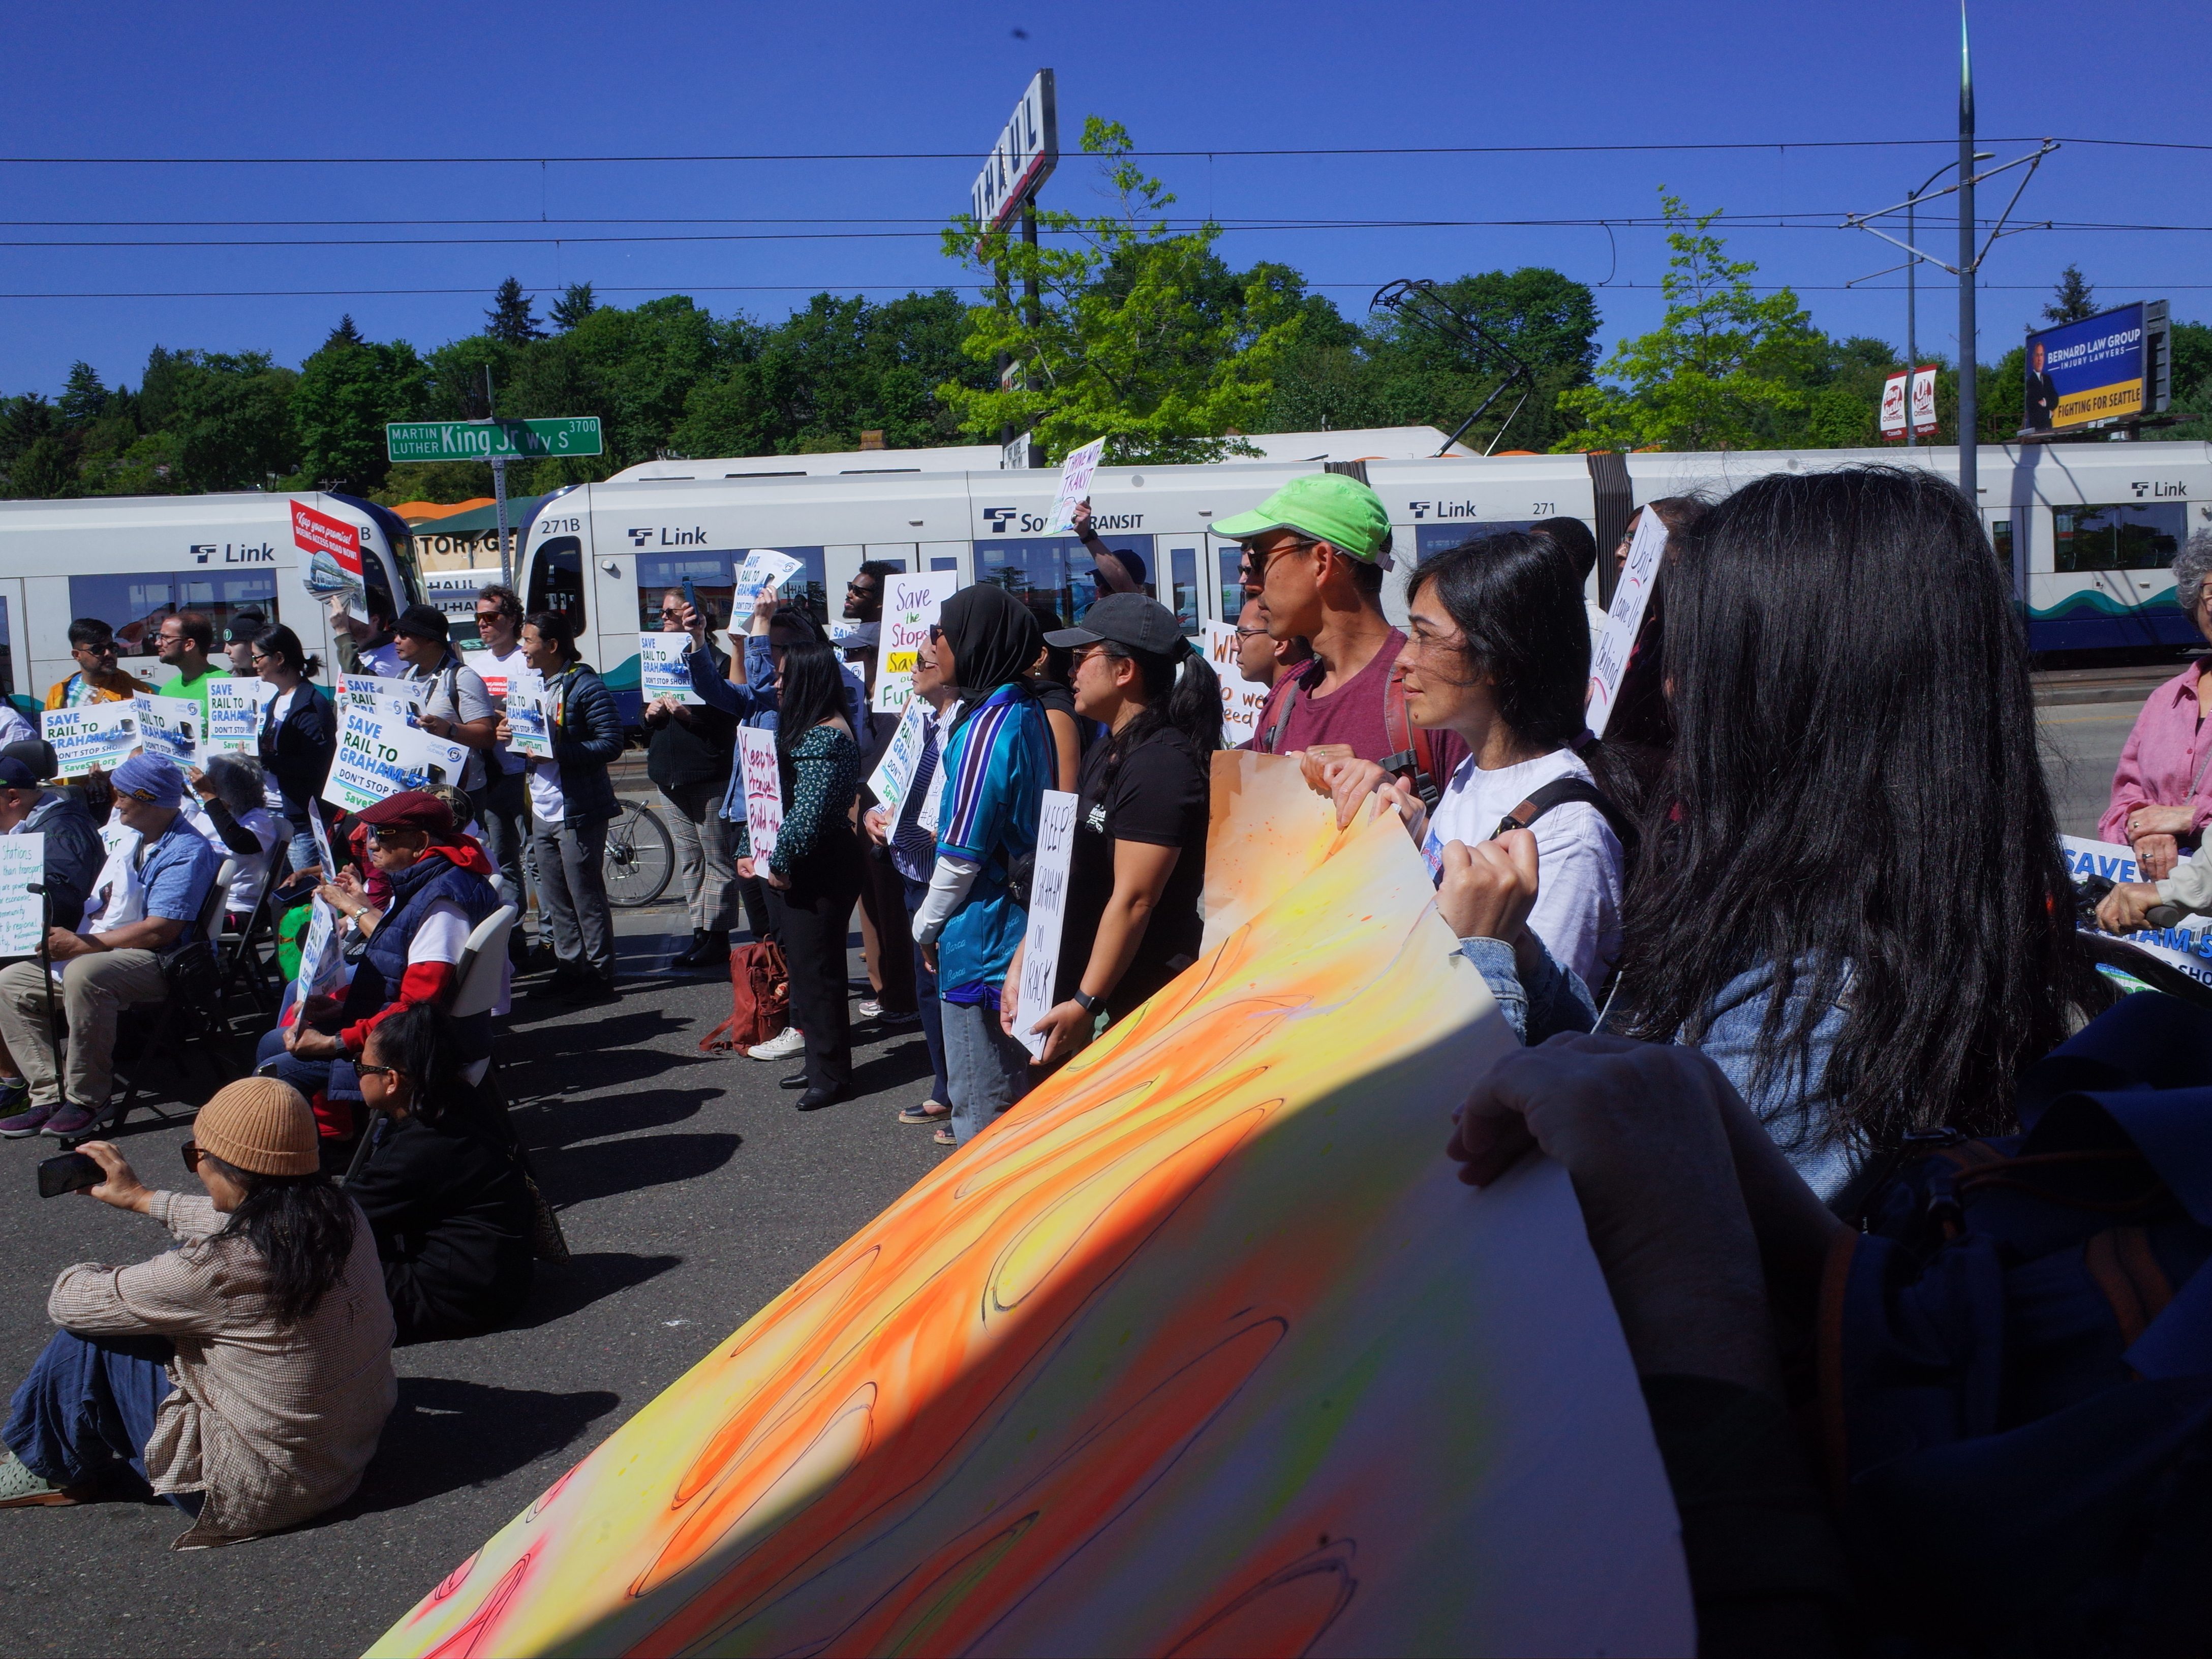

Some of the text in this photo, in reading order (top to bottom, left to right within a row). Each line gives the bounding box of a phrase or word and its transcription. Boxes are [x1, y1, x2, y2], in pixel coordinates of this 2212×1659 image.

[2048, 328, 2141, 364] BERNARD LAW GROUP
[2061, 346, 2125, 370] INJURY LAWYERS
[2058, 388, 2140, 418] FIGHTING FOR SEATTLE
[392, 428, 437, 440] MARTIN
[569, 421, 596, 433] 3700
[1917, 424, 1935, 433] English
[393, 442, 439, 454] LUTHER
[441, 425, 490, 456] King
[496, 424, 519, 451] Jr
[558, 431, 569, 448] S
[1065, 449, 1088, 475] THRIVE
[1062, 467, 1094, 497] TRANSIT
[2155, 481, 2187, 497] Link
[1437, 500, 1477, 517] Link
[1532, 503, 1555, 515] 271
[296, 512, 352, 545] Keep your promise!
[541, 518, 580, 534] 271B
[295, 526, 357, 561] BOEING ACCESS ROAD NOW!
[661, 526, 708, 545] Link
[225, 542, 275, 563] Link
[745, 556, 760, 568] SAVE
[752, 570, 760, 582] TO
[897, 582, 932, 611] Save
[435, 600, 477, 612] U-HA
[1612, 578, 1642, 636] Leave Us
[905, 611, 921, 624] the
[641, 637, 656, 649] SAVE
[643, 650, 666, 661] RAIL TO
[889, 652, 916, 673] Sav
[1595, 632, 1623, 695] Behind
[643, 662, 672, 673] GRAHAM
[211, 684, 232, 696] SAVE
[348, 680, 376, 693] SAVE
[212, 698, 243, 709] RAIL TO
[351, 693, 376, 705] RAIL
[517, 695, 526, 707] TO
[1243, 692, 1264, 710] we
[47, 713, 80, 726] SAVE
[153, 715, 165, 728] TO
[347, 715, 383, 740] SAVE
[906, 704, 919, 733] SAVE
[1223, 708, 1254, 729] eed
[48, 722, 99, 739] RAIL TO
[109, 729, 125, 741] ST
[900, 722, 911, 751] RAIL
[80, 747, 100, 756] STOP
[145, 741, 191, 759] DON'T STOP SHORT!
[343, 731, 398, 762] RAIL TO
[740, 730, 778, 772] Keep the
[340, 747, 431, 788] GRAHAM ST
[887, 759, 902, 782] DON'T
[339, 769, 365, 786] DON'T
[365, 779, 389, 794] STOP
[750, 801, 780, 834] Build the
[1040, 803, 1069, 854] KEEP
[3, 840, 32, 860] Stations
[4, 865, 16, 876] than
[6, 894, 32, 903] economic
[1034, 865, 1064, 916] GRAHAM
[13, 918, 37, 934] regional
[1034, 924, 1044, 952] on
[1023, 951, 1053, 1011] TRACK
